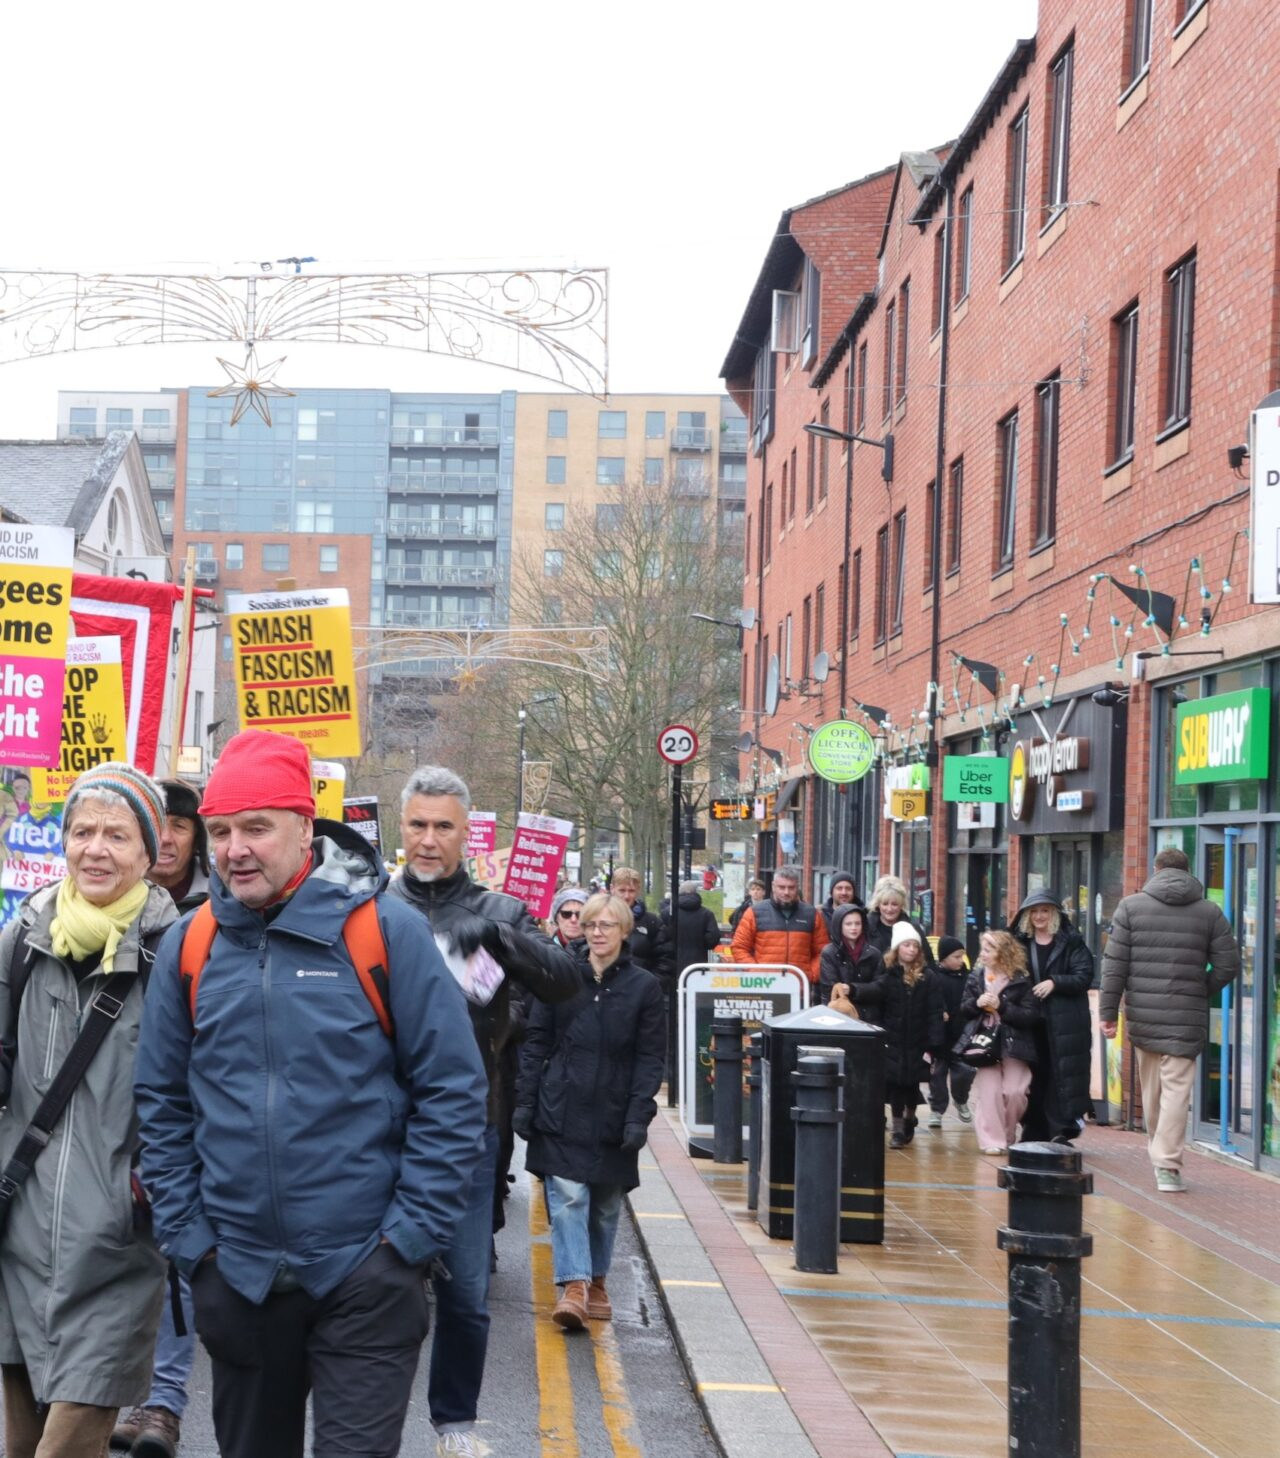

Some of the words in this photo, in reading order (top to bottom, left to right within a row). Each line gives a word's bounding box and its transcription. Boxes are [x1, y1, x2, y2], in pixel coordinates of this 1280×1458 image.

[15, 531, 33, 545] UP
[248, 598, 292, 611] Socialist
[292, 596, 330, 608] Worker
[238, 613, 313, 646] SMASH
[73, 652, 102, 661] RACISM
[241, 649, 334, 682] FASCISM
[67, 667, 99, 693] OP
[62, 694, 86, 719] HE
[245, 690, 261, 718] &
[267, 685, 352, 716] RACISM
[664, 736, 692, 753] 20
[1178, 701, 1250, 773] SUBWAY
[47, 776, 60, 785] No
[960, 770, 993, 781] Uber
[48, 788, 61, 797] No
[960, 783, 993, 795] Eats
[470, 825, 492, 834] ugees
[517, 836, 560, 856] Refugees
[513, 853, 529, 865] are
[6, 858, 69, 878] KNOWLE
[510, 865, 521, 878] to
[14, 873, 29, 888] IS
[507, 880, 529, 896] Stop
[530, 883, 545, 897] the
[710, 976, 777, 989] SUBWAY
[714, 999, 774, 1009] ULTIMATE
